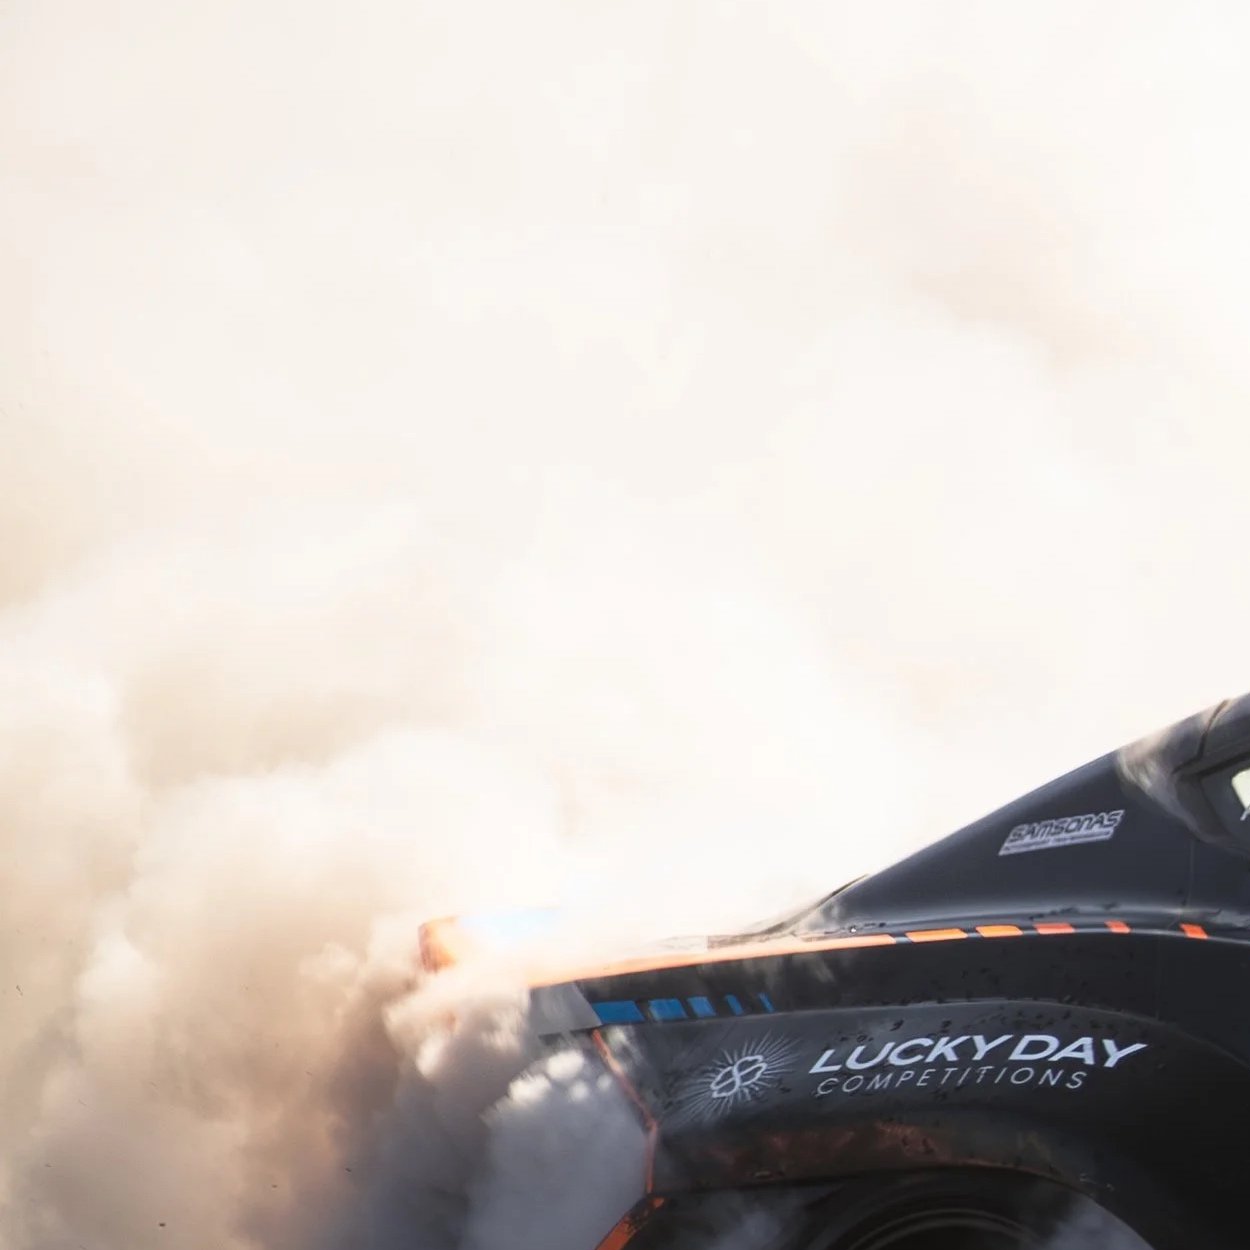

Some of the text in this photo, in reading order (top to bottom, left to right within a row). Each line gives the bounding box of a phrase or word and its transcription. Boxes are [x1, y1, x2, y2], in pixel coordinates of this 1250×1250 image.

[808, 1034, 1148, 1074] LUCKY DAY
[815, 1065, 1089, 1096] COMPETITIONS
